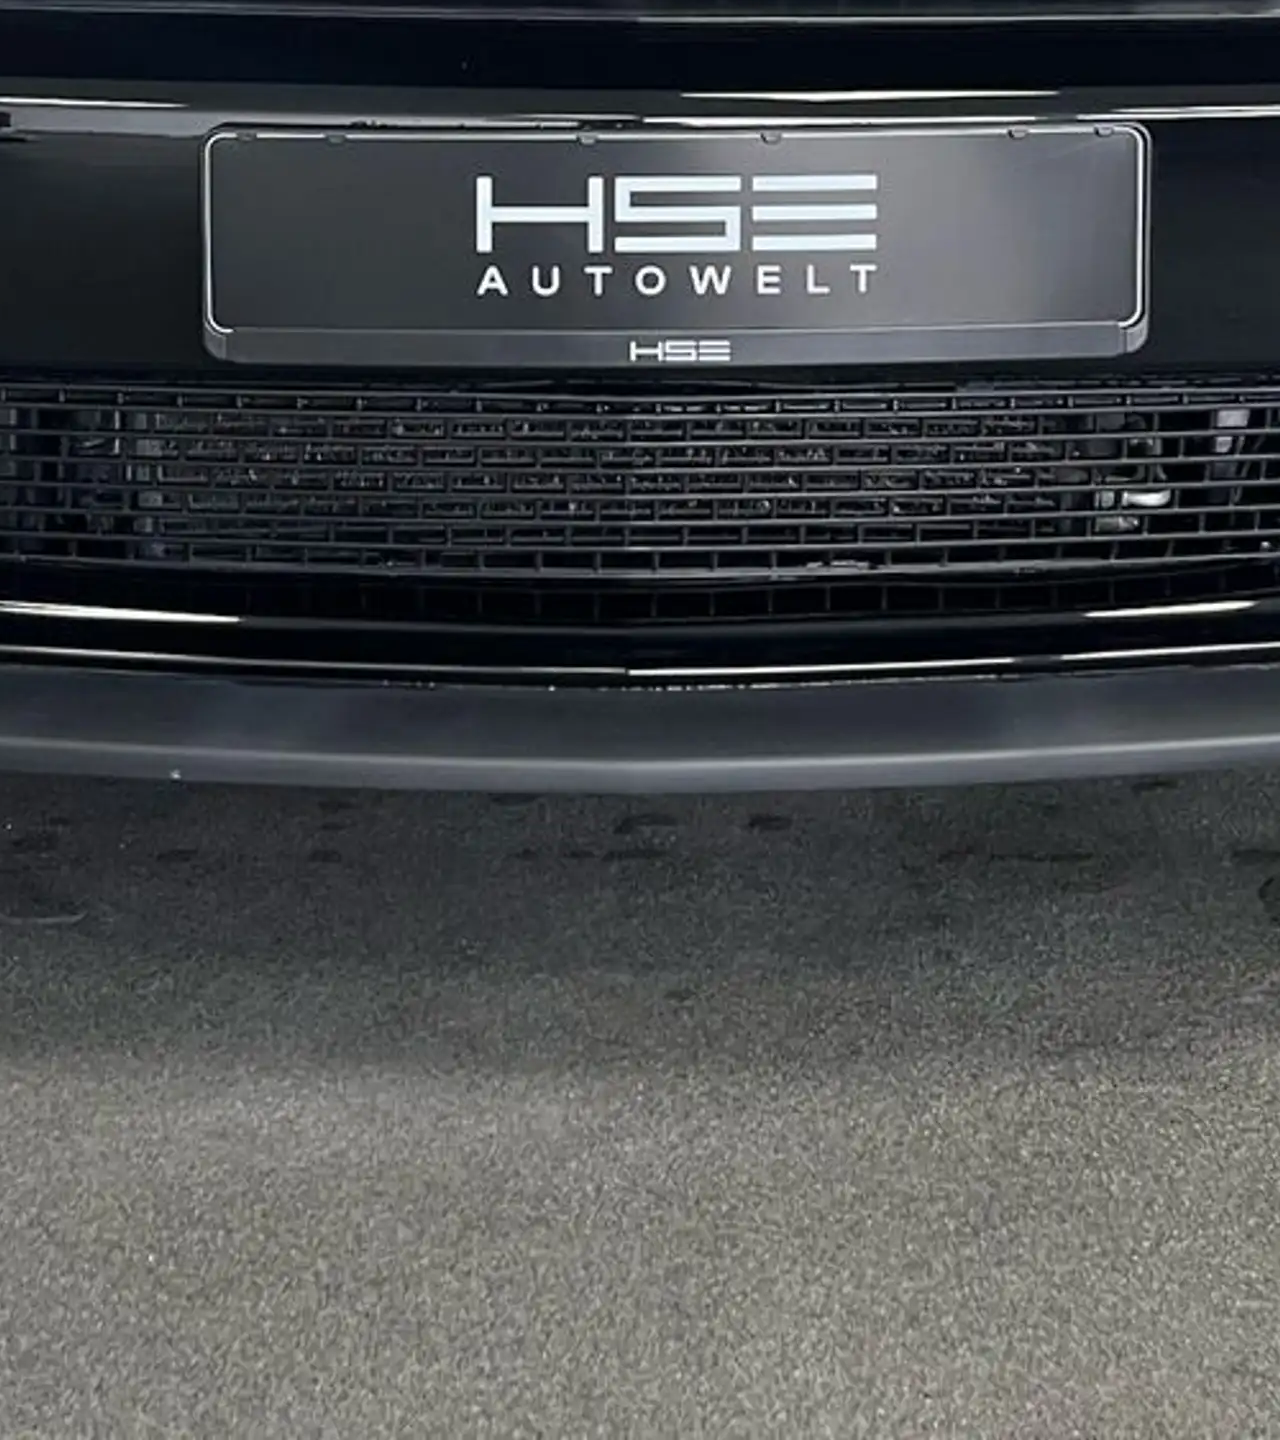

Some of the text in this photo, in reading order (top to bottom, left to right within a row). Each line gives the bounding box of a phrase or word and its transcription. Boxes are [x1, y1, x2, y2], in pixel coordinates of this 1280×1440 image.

[476, 174, 879, 253] HSE
[477, 263, 878, 296] AUTOWELT
[629, 339, 732, 362] HSE
